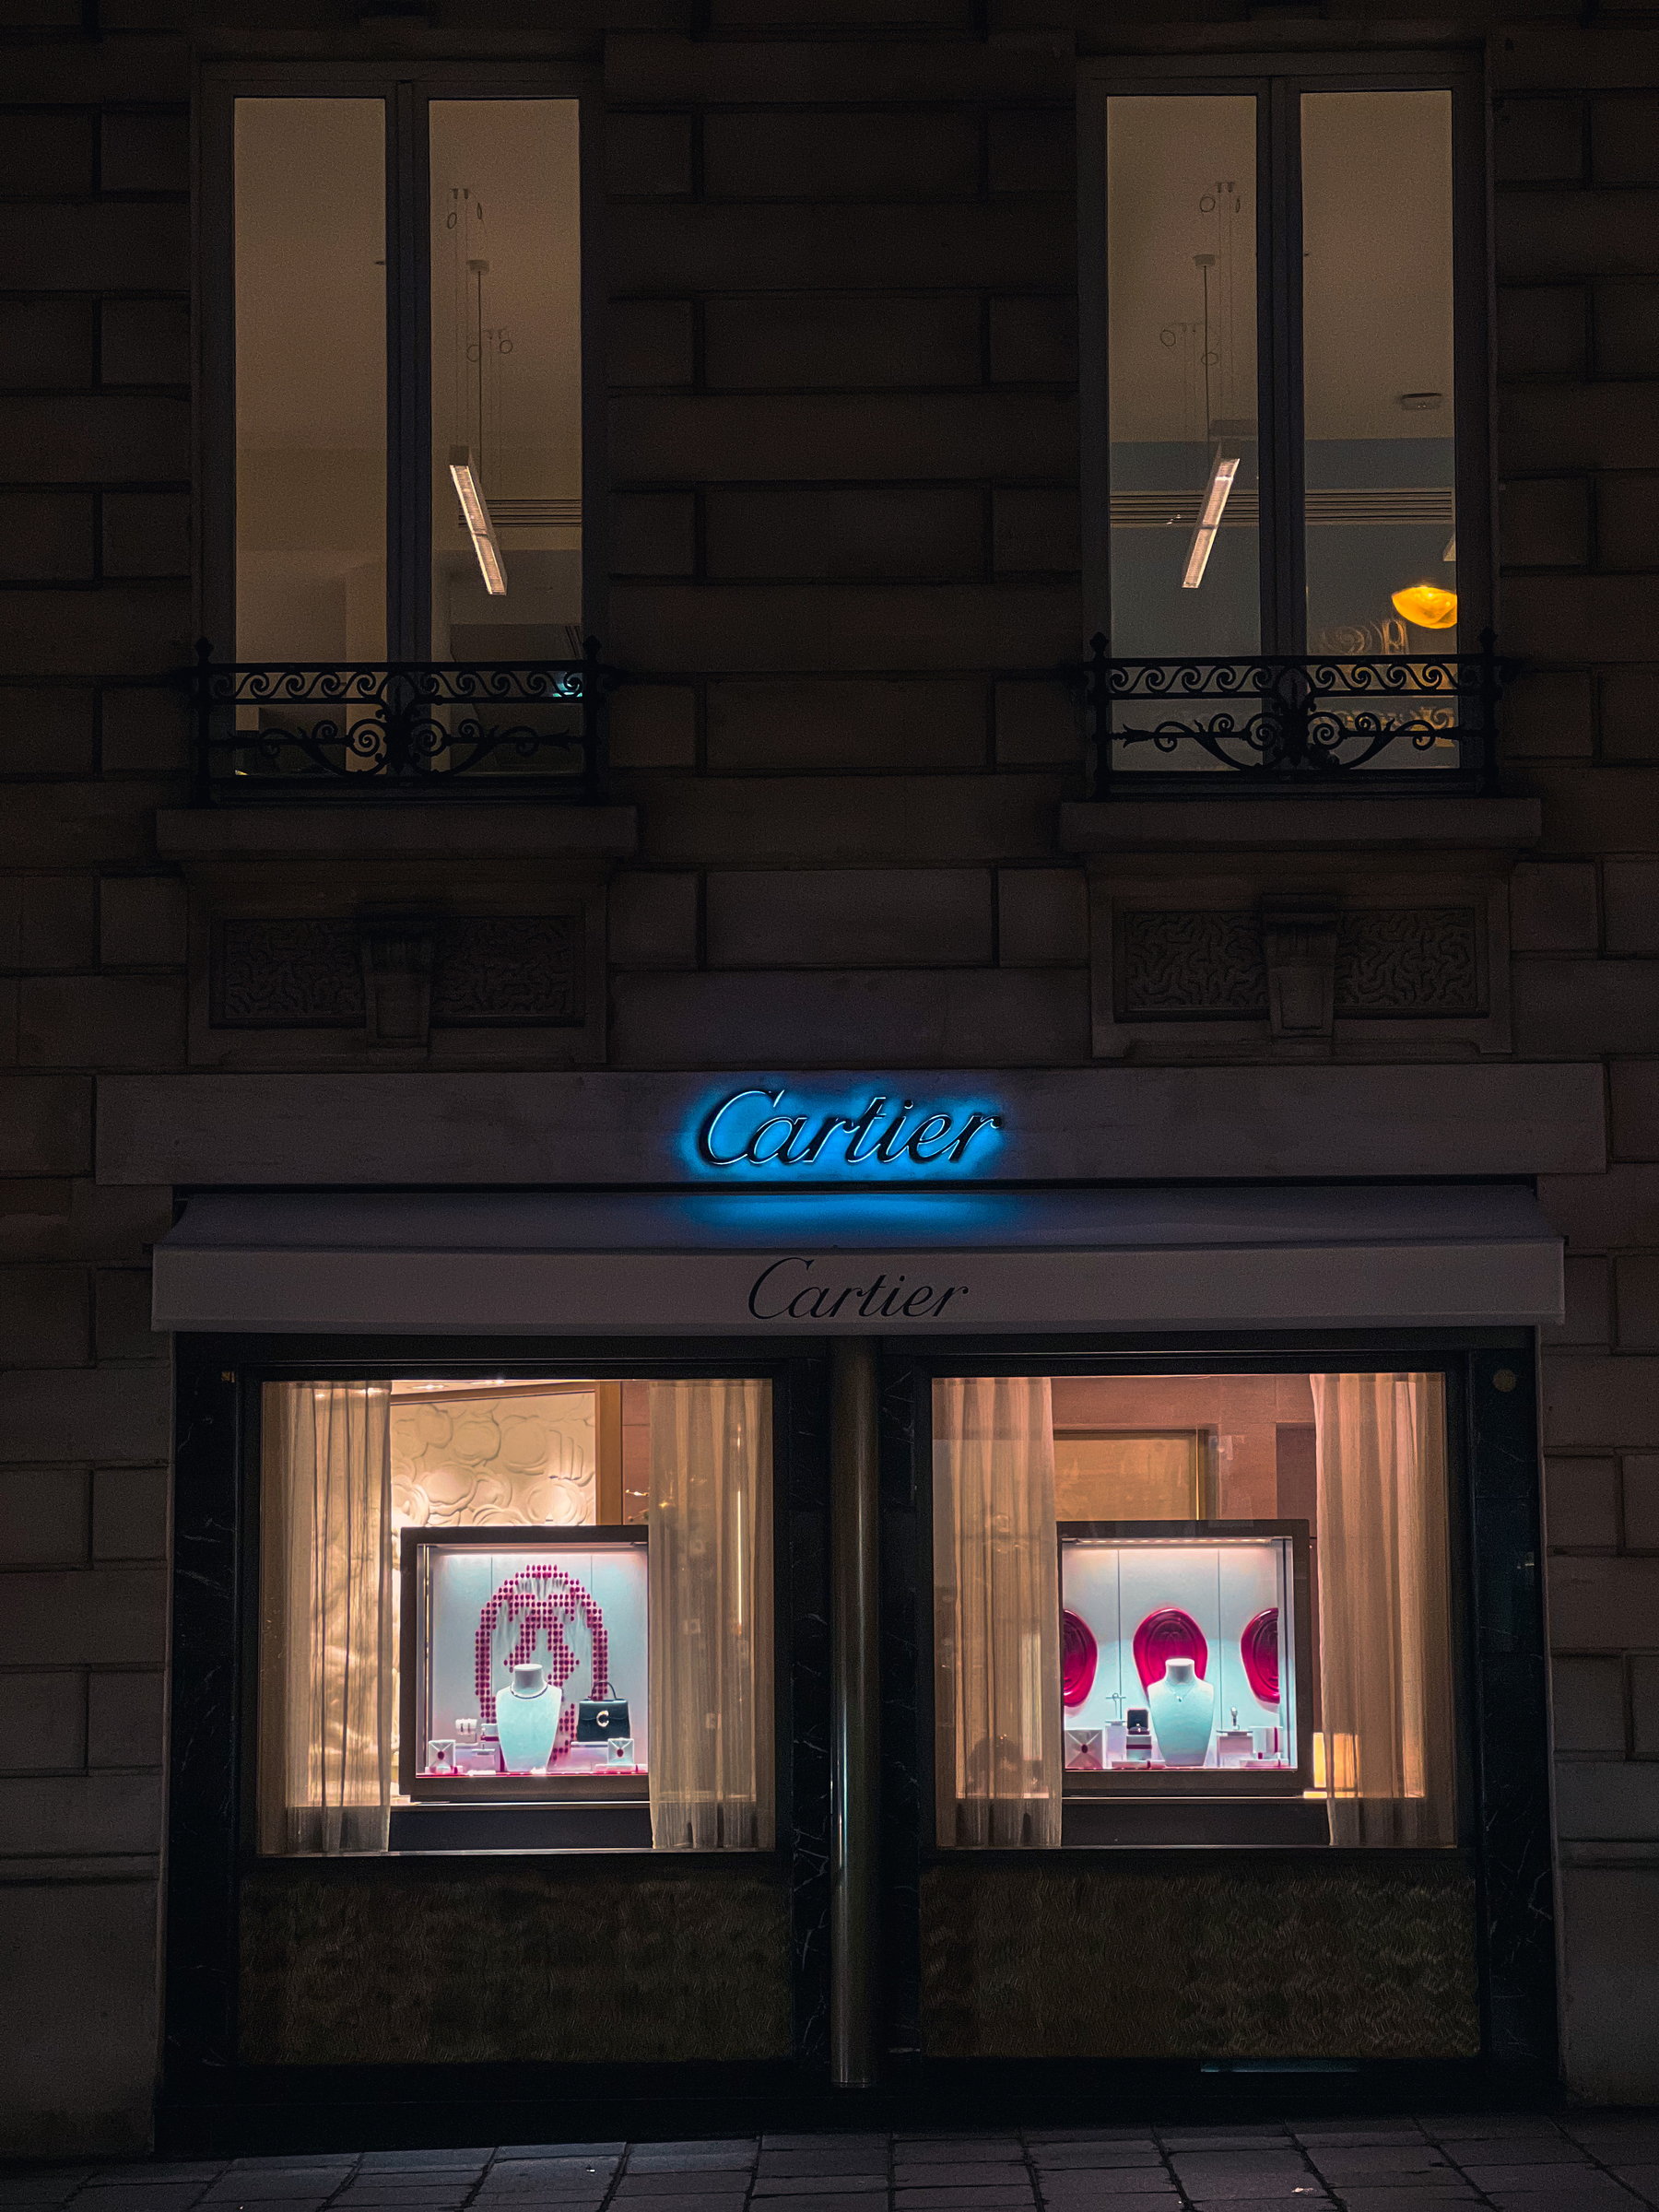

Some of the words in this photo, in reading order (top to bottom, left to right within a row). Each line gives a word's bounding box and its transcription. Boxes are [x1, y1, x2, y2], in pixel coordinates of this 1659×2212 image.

[699, 1089, 1003, 1164] Cartier
[747, 1256, 969, 1319] Cartier
[596, 1710, 609, 1727] C
